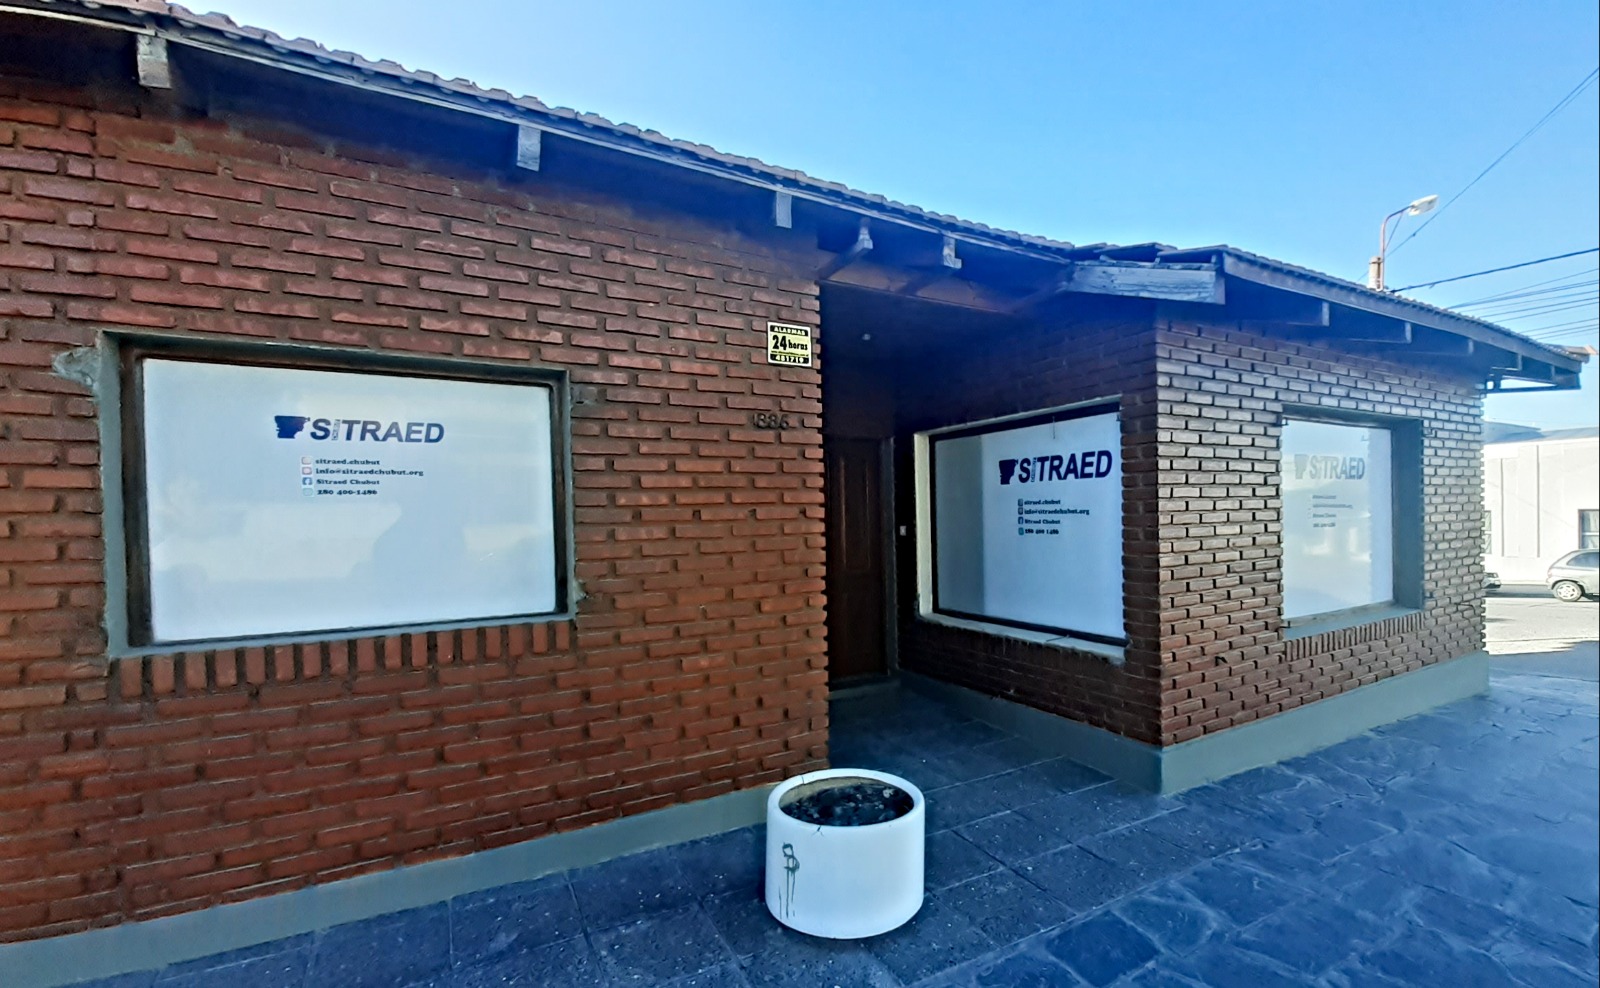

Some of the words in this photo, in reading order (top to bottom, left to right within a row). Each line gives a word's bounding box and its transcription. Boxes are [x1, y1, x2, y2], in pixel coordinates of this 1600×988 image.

[773, 326, 806, 336] ALARMAS
[772, 335, 787, 351] 24
[788, 339, 808, 351] horas
[310, 418, 445, 443] SITRAED
[316, 468, 424, 476] info@sitraedchubut.org
[1018, 450, 1113, 483] SITRAED
